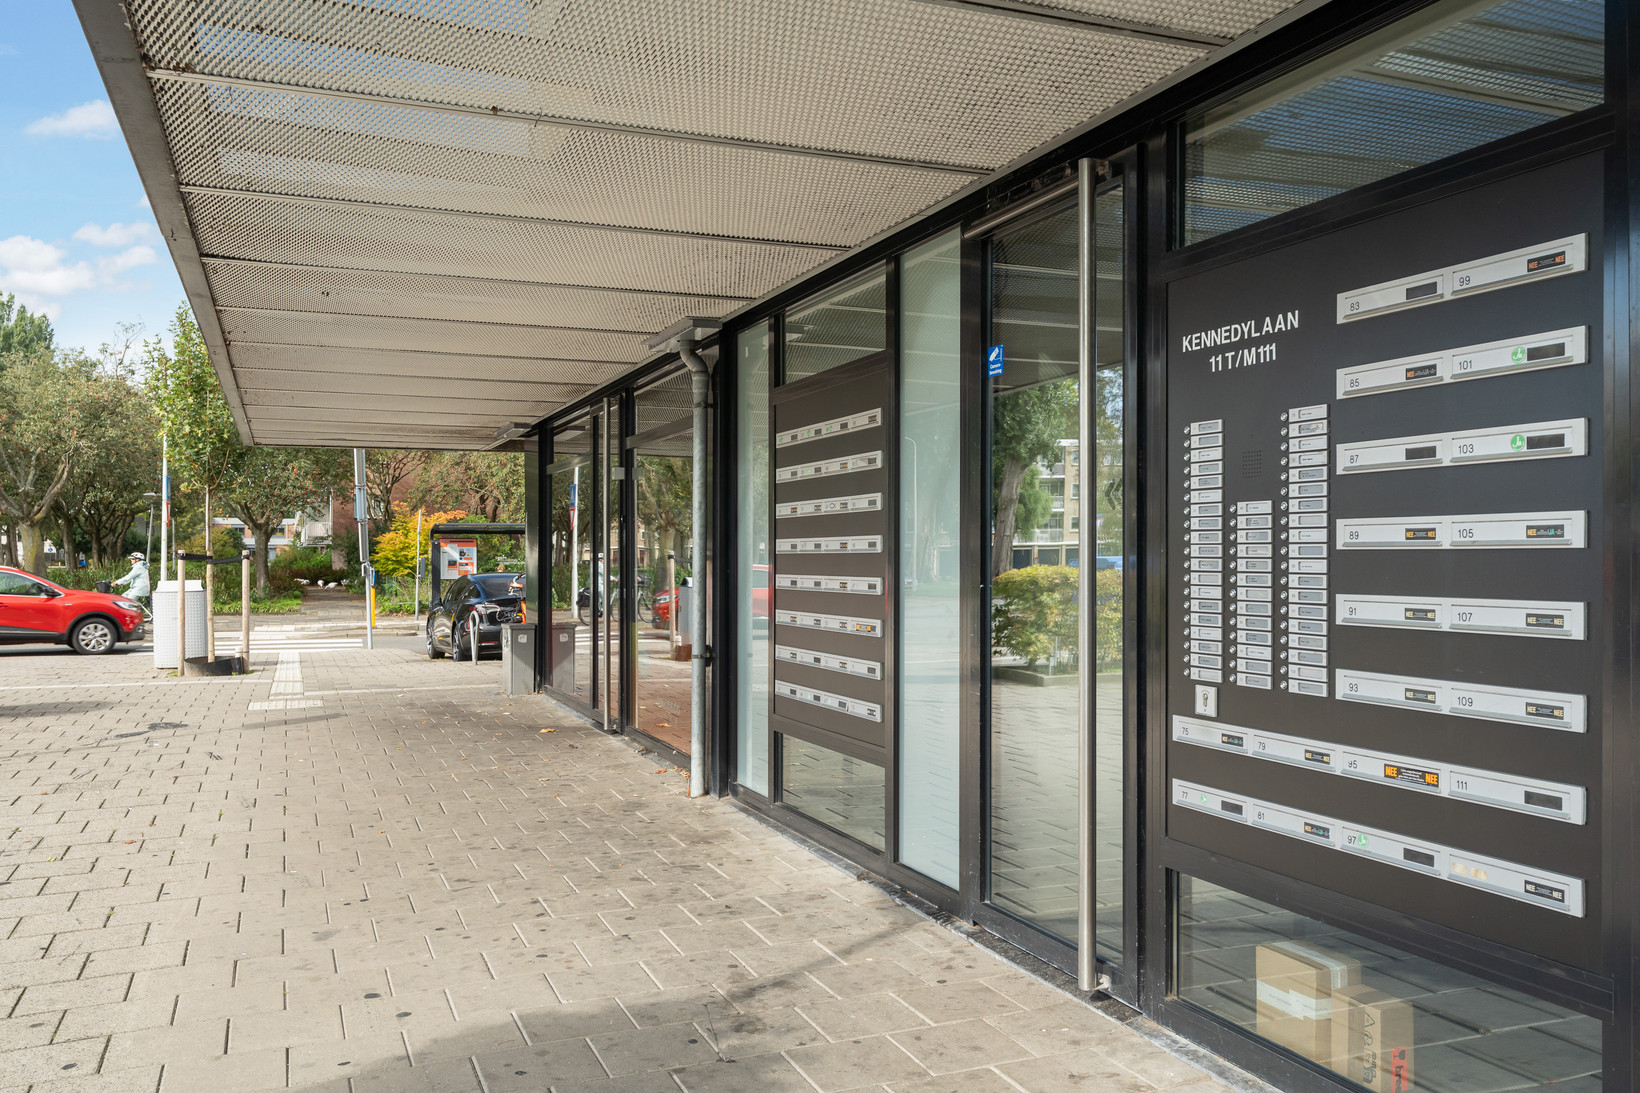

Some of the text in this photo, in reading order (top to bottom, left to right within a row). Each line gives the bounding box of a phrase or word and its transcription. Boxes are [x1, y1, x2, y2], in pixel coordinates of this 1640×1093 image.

[1555, 254, 1565, 264] NEE
[1529, 260, 1538, 270] NEE
[1459, 276, 1471, 287] 99
[1350, 301, 1360, 312] 83
[1182, 310, 1299, 353] KENNEDYLAAN
[1458, 360, 1473, 370] 101
[1349, 378, 1360, 388] 85
[1458, 444, 1474, 454] 103
[1350, 454, 1359, 464] 87
[1349, 531, 1360, 540] 89
[1458, 529, 1474, 539] 105
[1348, 607, 1357, 616] 91
[1457, 613, 1473, 622] 107
[1554, 618, 1564, 626] NEE
[1348, 683, 1359, 693] 93
[1457, 696, 1473, 707] 109
[1527, 706, 1537, 714] NEE
[1554, 709, 1564, 717] NEE
[1182, 727, 1189, 735] 75
[1258, 742, 1266, 750] 79
[1348, 760, 1357, 769] 95
[1385, 766, 1398, 777] NEE
[1425, 773, 1438, 785] NEE
[1456, 780, 1468, 790] 111
[1257, 812, 1265, 820] 81
[1347, 836, 1357, 845] 97
[1526, 884, 1536, 893] NEE
[1552, 891, 1563, 900] NEE
